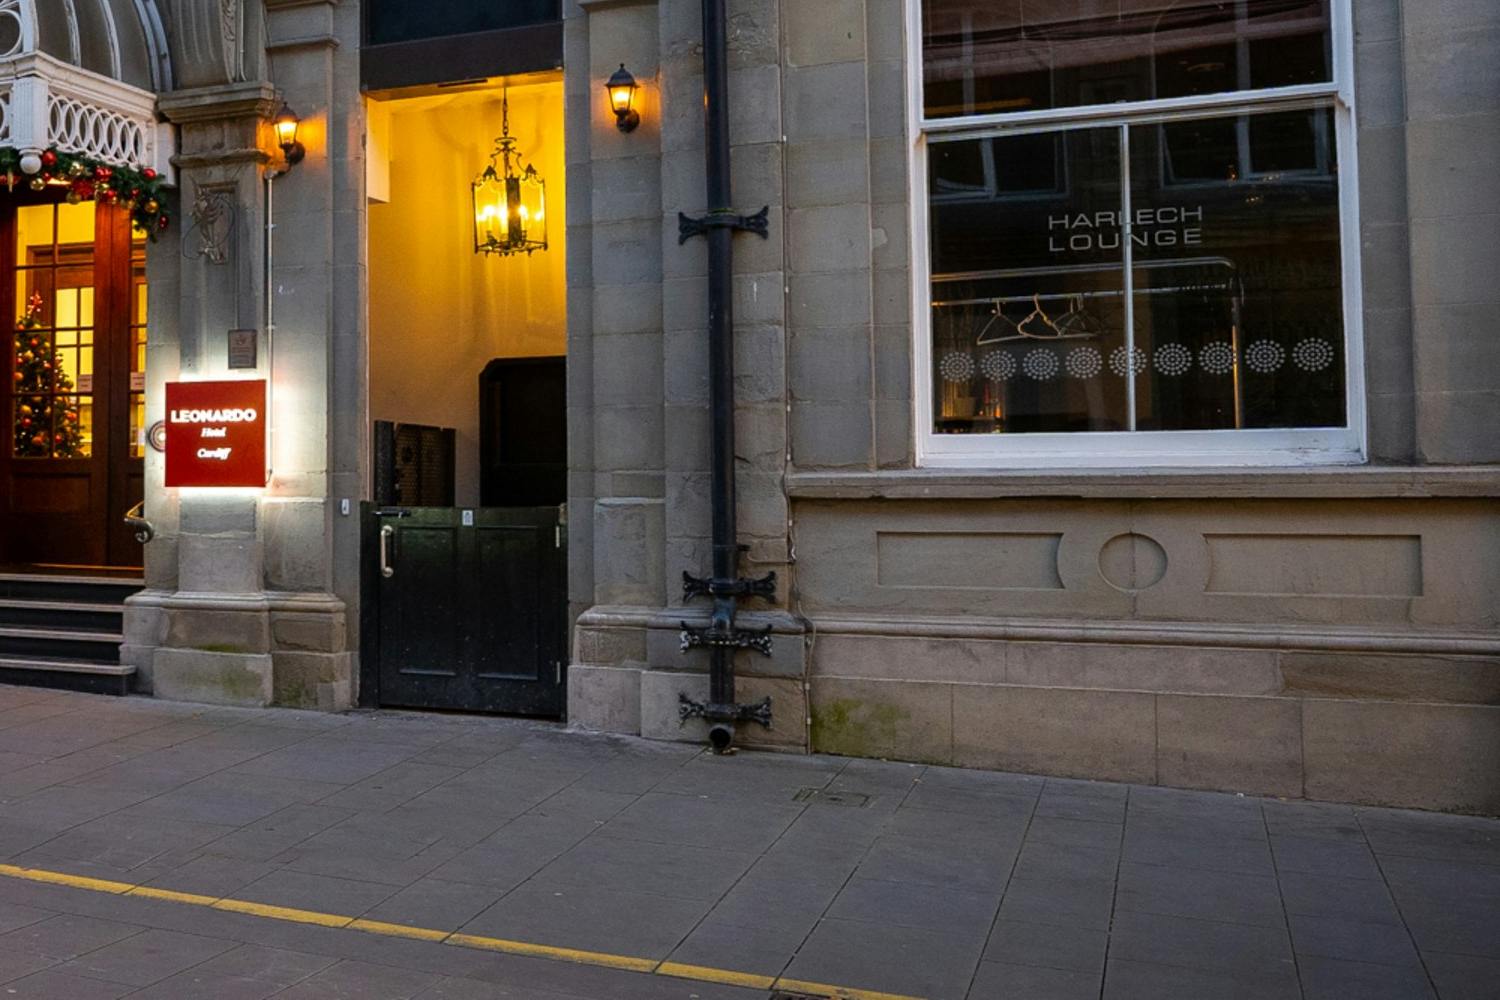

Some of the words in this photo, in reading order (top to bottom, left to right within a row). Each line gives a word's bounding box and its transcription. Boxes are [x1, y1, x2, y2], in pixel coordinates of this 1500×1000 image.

[1049, 205, 1203, 230] HARLECH
[1049, 228, 1202, 253] LOUNGE
[170, 408, 257, 423] LEONARDO
